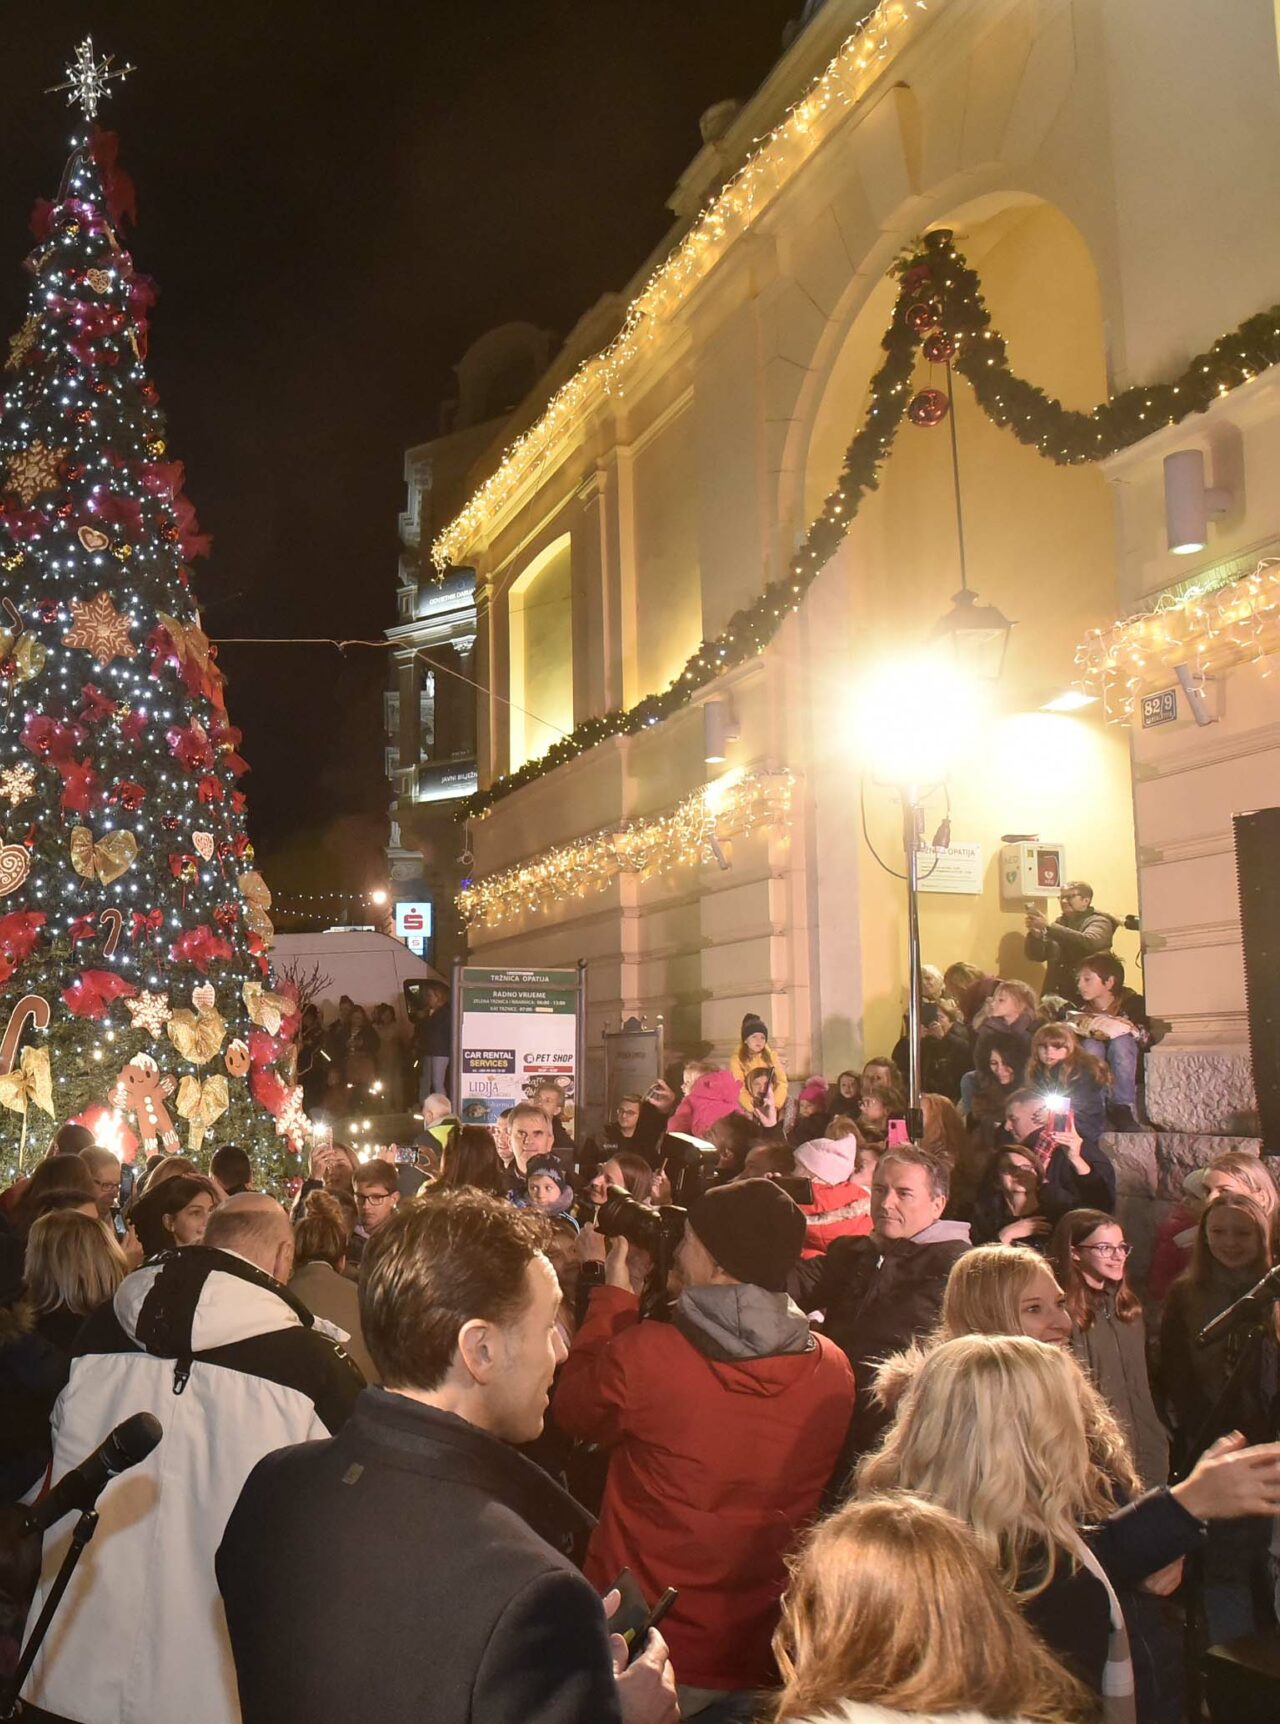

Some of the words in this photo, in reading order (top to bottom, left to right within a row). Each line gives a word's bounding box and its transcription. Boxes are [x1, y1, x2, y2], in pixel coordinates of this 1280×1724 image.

[490, 974, 520, 982] TRŽNICA
[522, 975, 550, 983] OPATIJA
[492, 990, 518, 998] RADNO
[464, 1051, 481, 1059] CAR
[482, 1051, 514, 1059] RENTAL
[535, 1053, 550, 1063] PET
[552, 1053, 573, 1063] SHOP
[469, 1059, 508, 1067] SERVICES
[469, 1081, 499, 1097] LIDIJA
